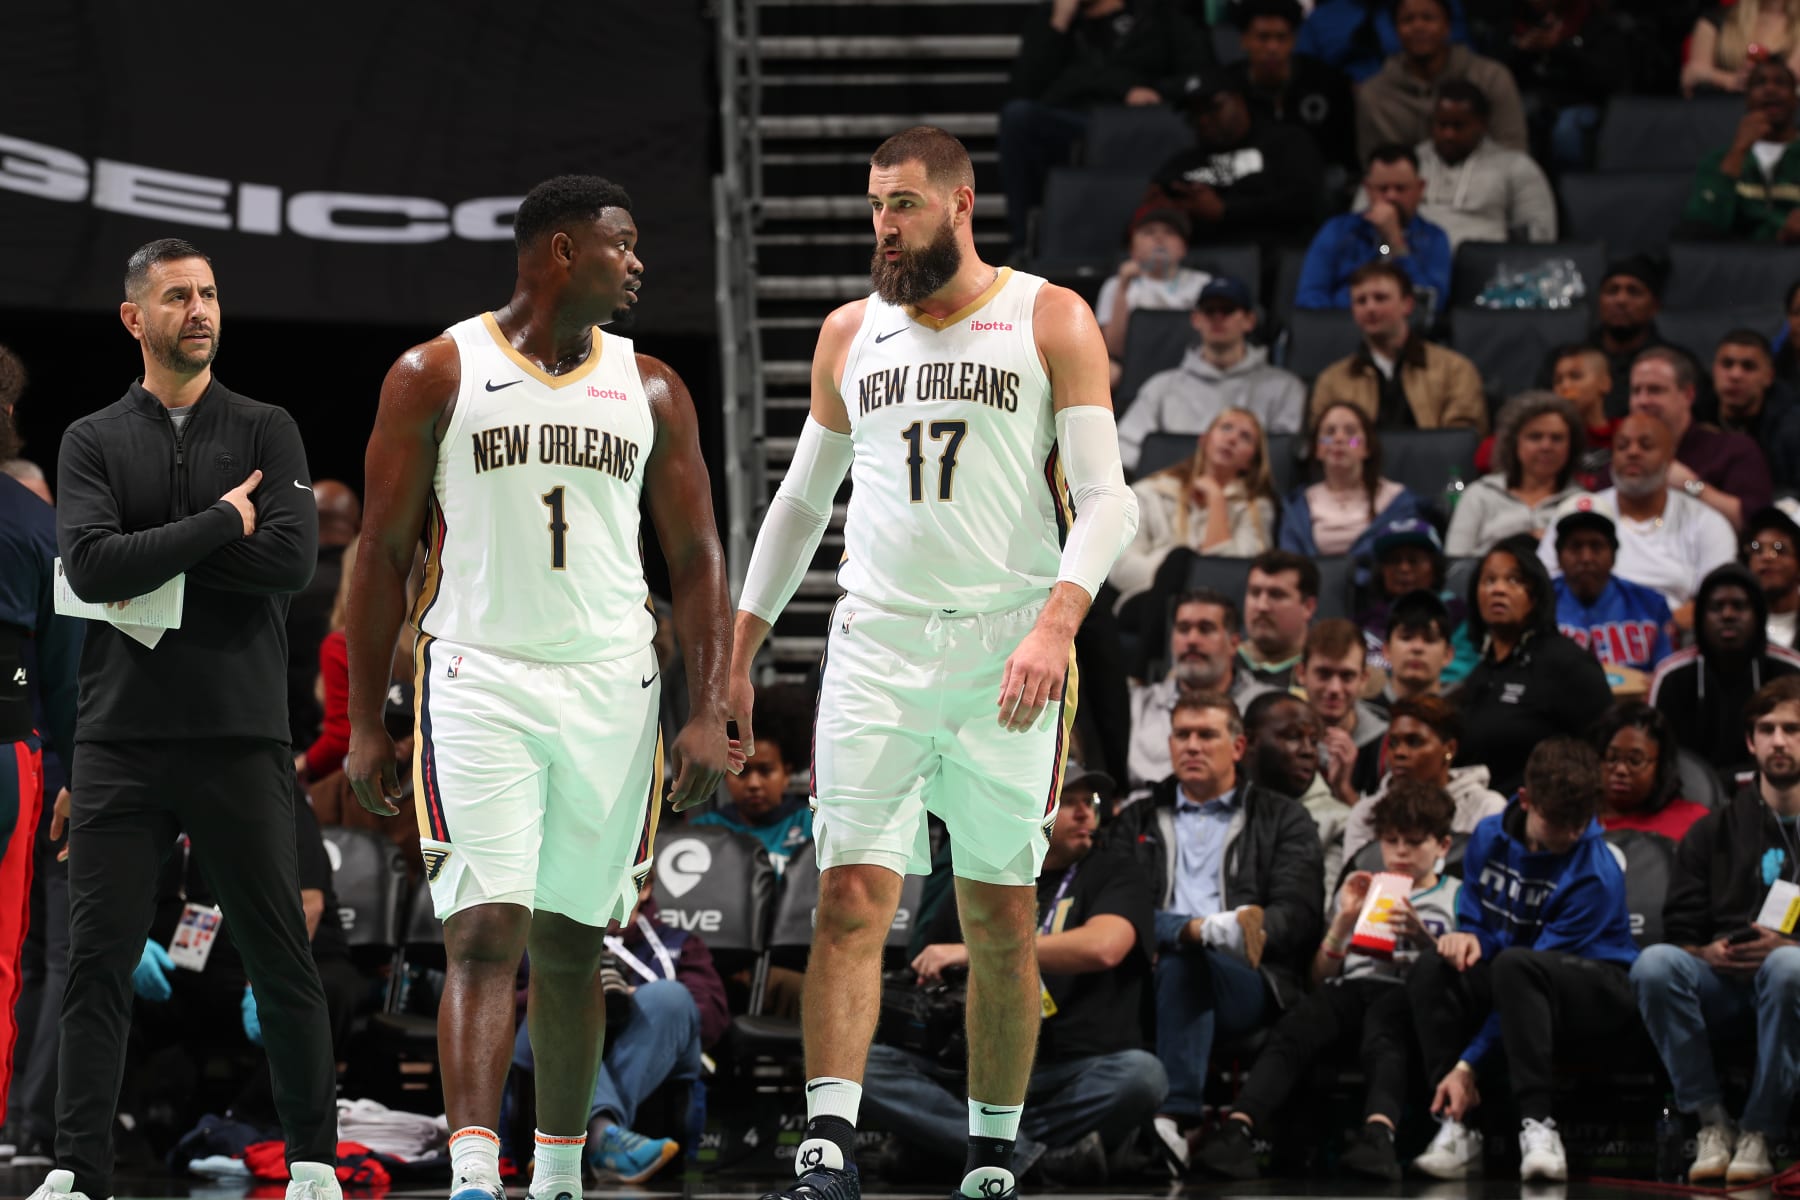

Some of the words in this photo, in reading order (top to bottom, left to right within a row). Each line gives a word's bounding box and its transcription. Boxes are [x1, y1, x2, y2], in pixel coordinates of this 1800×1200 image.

[970, 320, 1013, 332] ibotta
[587, 385, 627, 401] ibotta
[858, 365, 911, 418] NEW
[916, 361, 1020, 414] ORLEANS
[472, 424, 530, 475] NEW
[538, 424, 639, 483] ORLEANS
[901, 418, 968, 504] 17
[541, 485, 569, 571] 1
